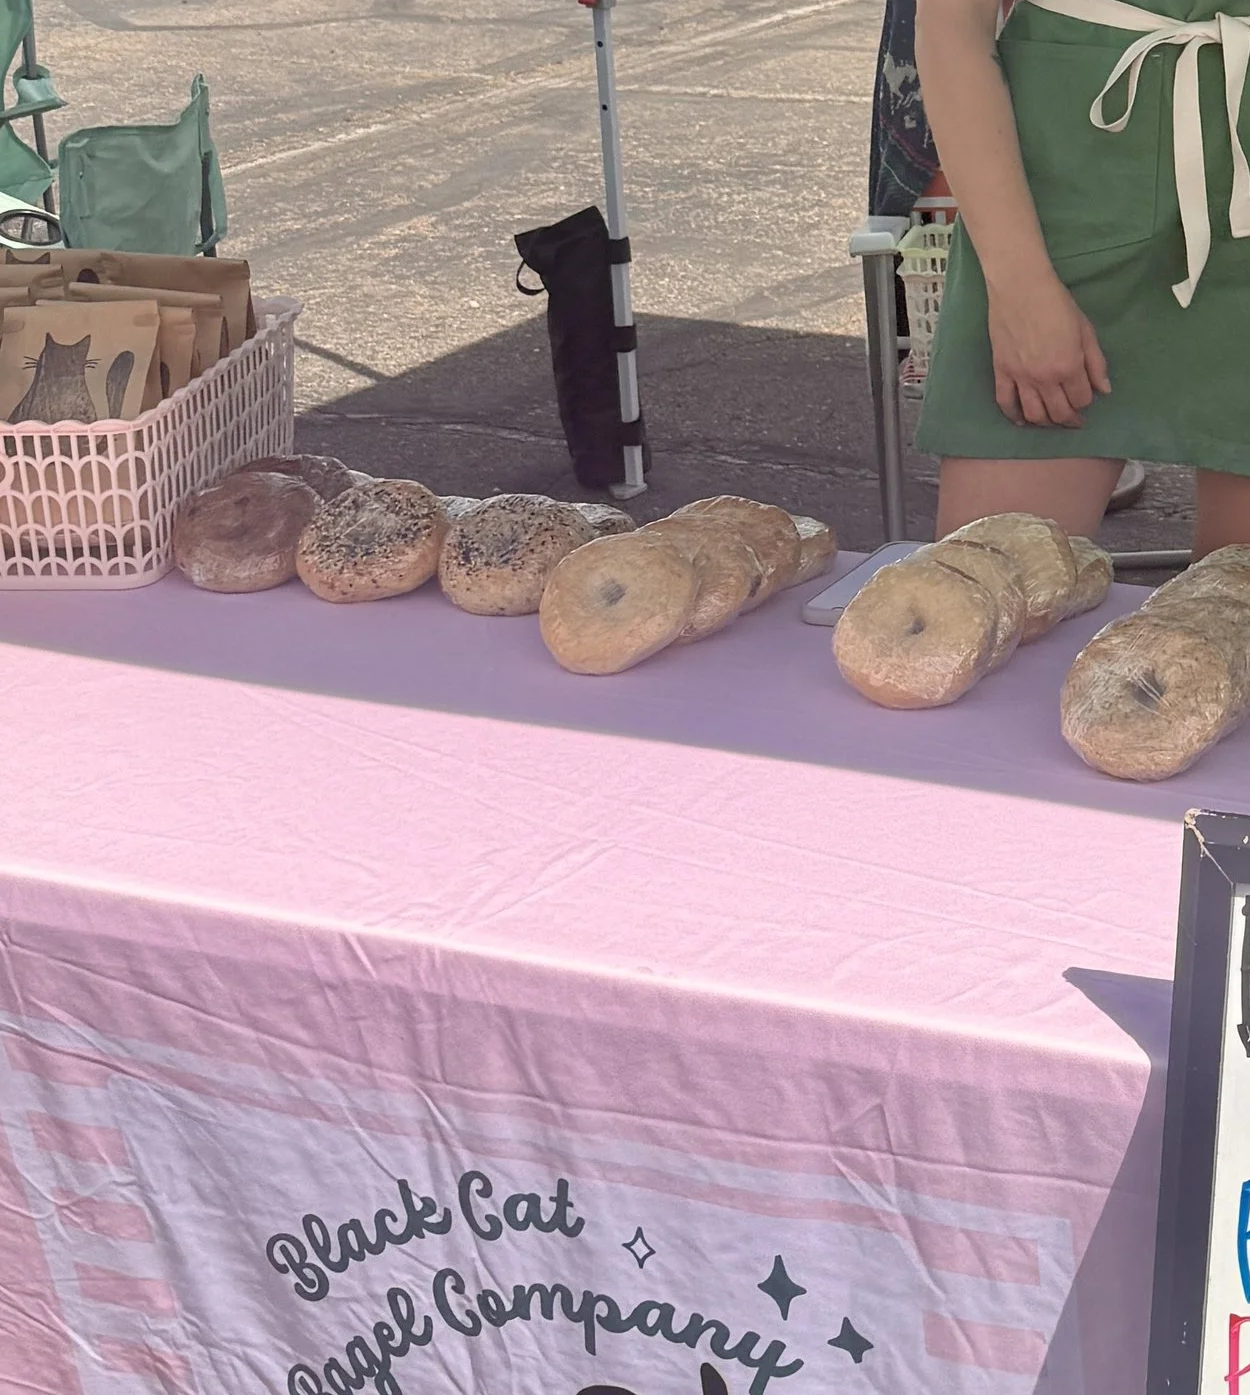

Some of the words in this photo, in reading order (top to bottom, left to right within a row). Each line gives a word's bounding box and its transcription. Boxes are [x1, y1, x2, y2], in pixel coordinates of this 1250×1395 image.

[266, 1178, 452, 1302] Black
[457, 1170, 586, 1242] Cat
[432, 1267, 805, 1395] Company
